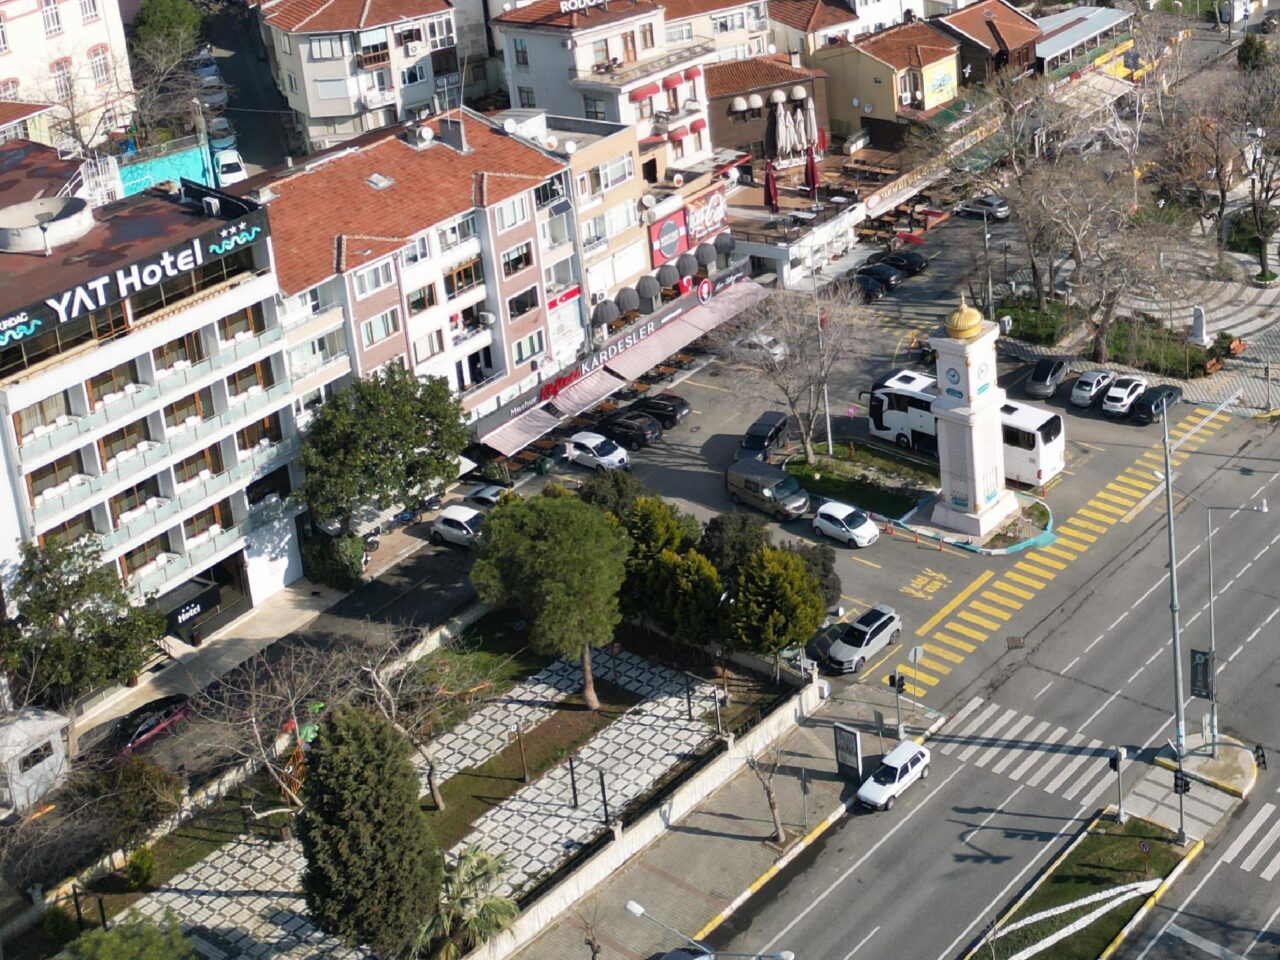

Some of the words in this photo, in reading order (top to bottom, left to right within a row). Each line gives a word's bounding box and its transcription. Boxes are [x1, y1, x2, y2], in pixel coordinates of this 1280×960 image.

[45, 276, 110, 323] YAT
[115, 238, 204, 298] Hotel
[177, 603, 201, 624] Hotel
